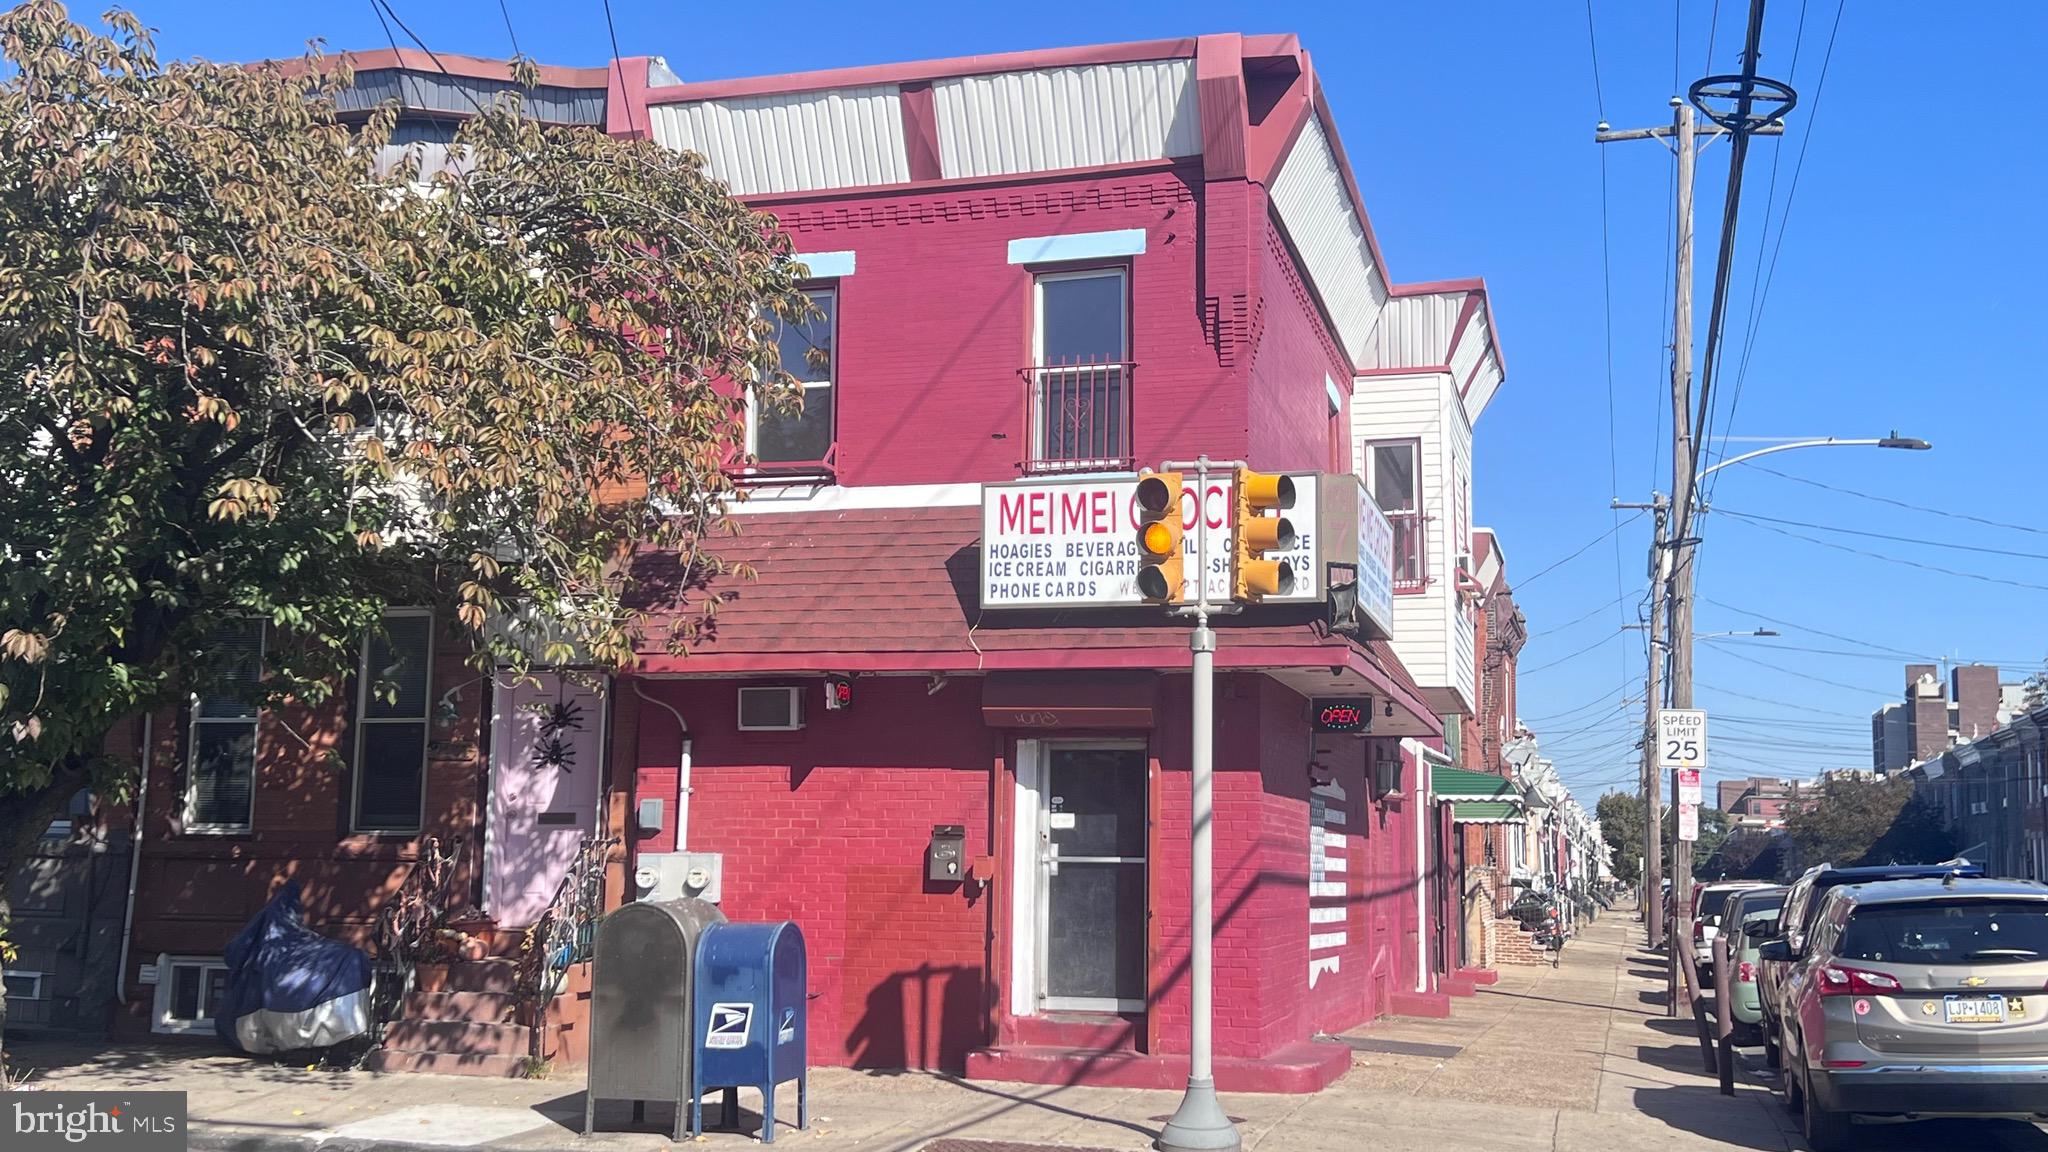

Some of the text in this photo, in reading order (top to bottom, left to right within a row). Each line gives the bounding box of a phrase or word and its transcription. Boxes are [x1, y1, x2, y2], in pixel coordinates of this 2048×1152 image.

[990, 543, 1052, 559] HOAGIES
[1065, 541, 1137, 558] BEVERAG
[989, 562, 1011, 577] ICE
[1016, 561, 1066, 577] CREAM
[990, 583, 1040, 599] PHONE
[1045, 581, 1097, 597] CARDS
[1320, 708, 1361, 724] OPEN
[1663, 716, 1702, 726] SPEED
[1667, 727, 1697, 737] LIMIT
[1667, 740, 1698, 760] 25
